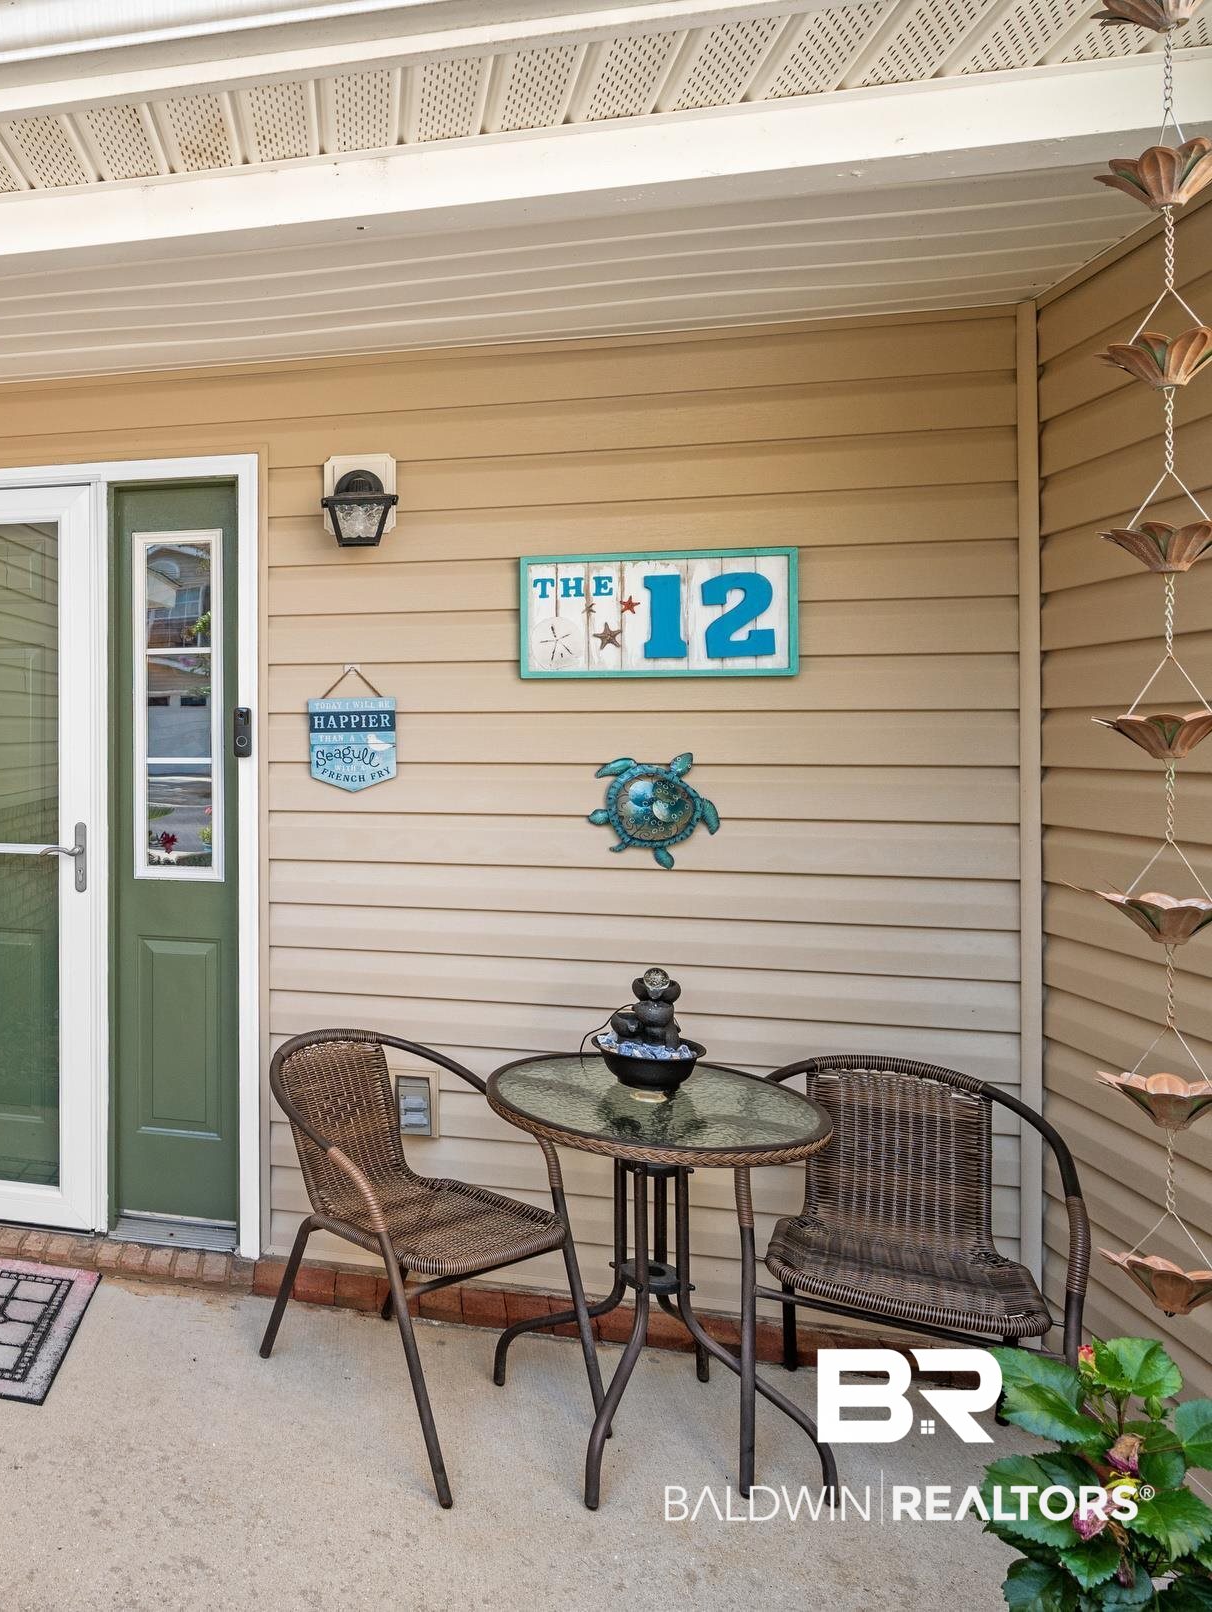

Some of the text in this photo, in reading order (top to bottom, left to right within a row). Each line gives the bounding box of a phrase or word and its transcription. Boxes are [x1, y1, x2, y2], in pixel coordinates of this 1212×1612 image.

[532, 575, 613, 599] THE
[643, 571, 776, 659] 12
[314, 702, 341, 710] TODAY
[313, 713, 391, 729] HAPPIER
[319, 734, 344, 743] THAN
[316, 746, 380, 768] Seagull
[321, 766, 391, 783] FRENCH FRY
